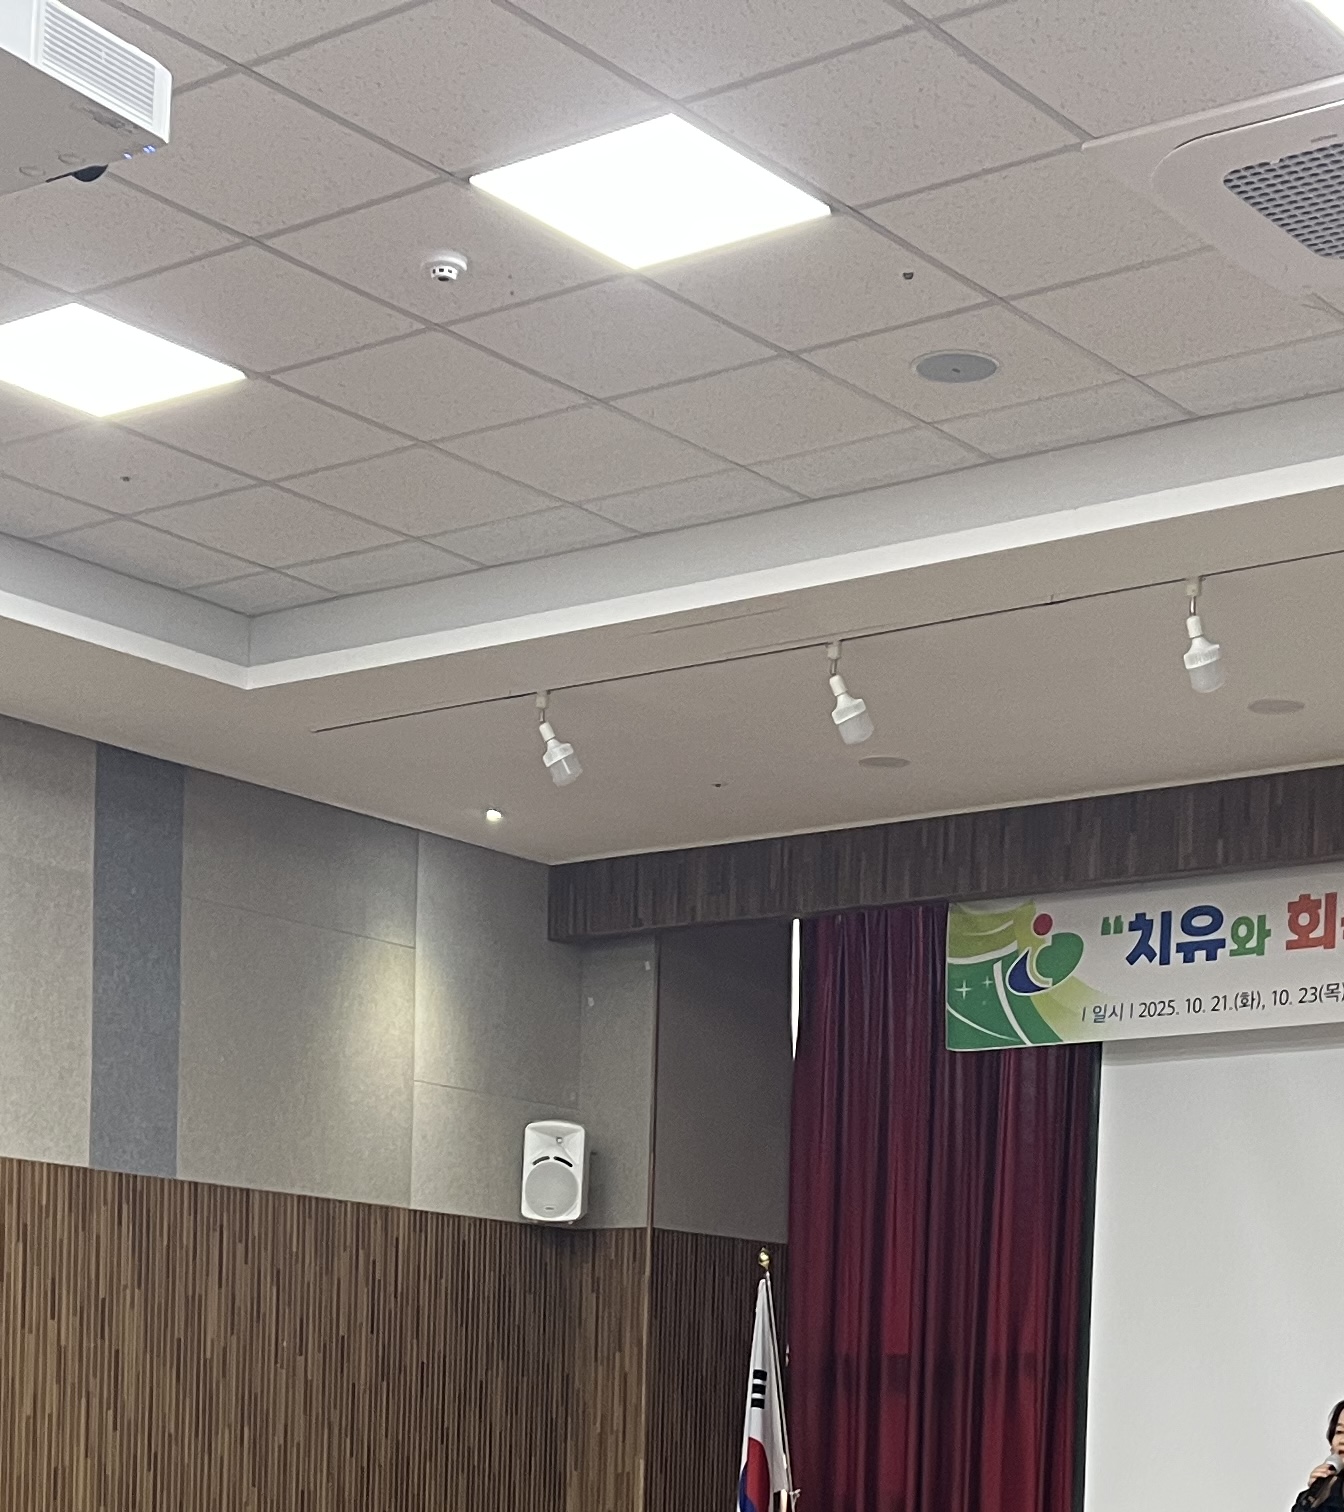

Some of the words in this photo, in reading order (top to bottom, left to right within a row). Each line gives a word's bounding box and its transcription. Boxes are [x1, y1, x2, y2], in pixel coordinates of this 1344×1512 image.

[1138, 999, 1180, 1018] 2025.
[1185, 997, 1206, 1014] 10.
[1271, 988, 1293, 1006] 10.
